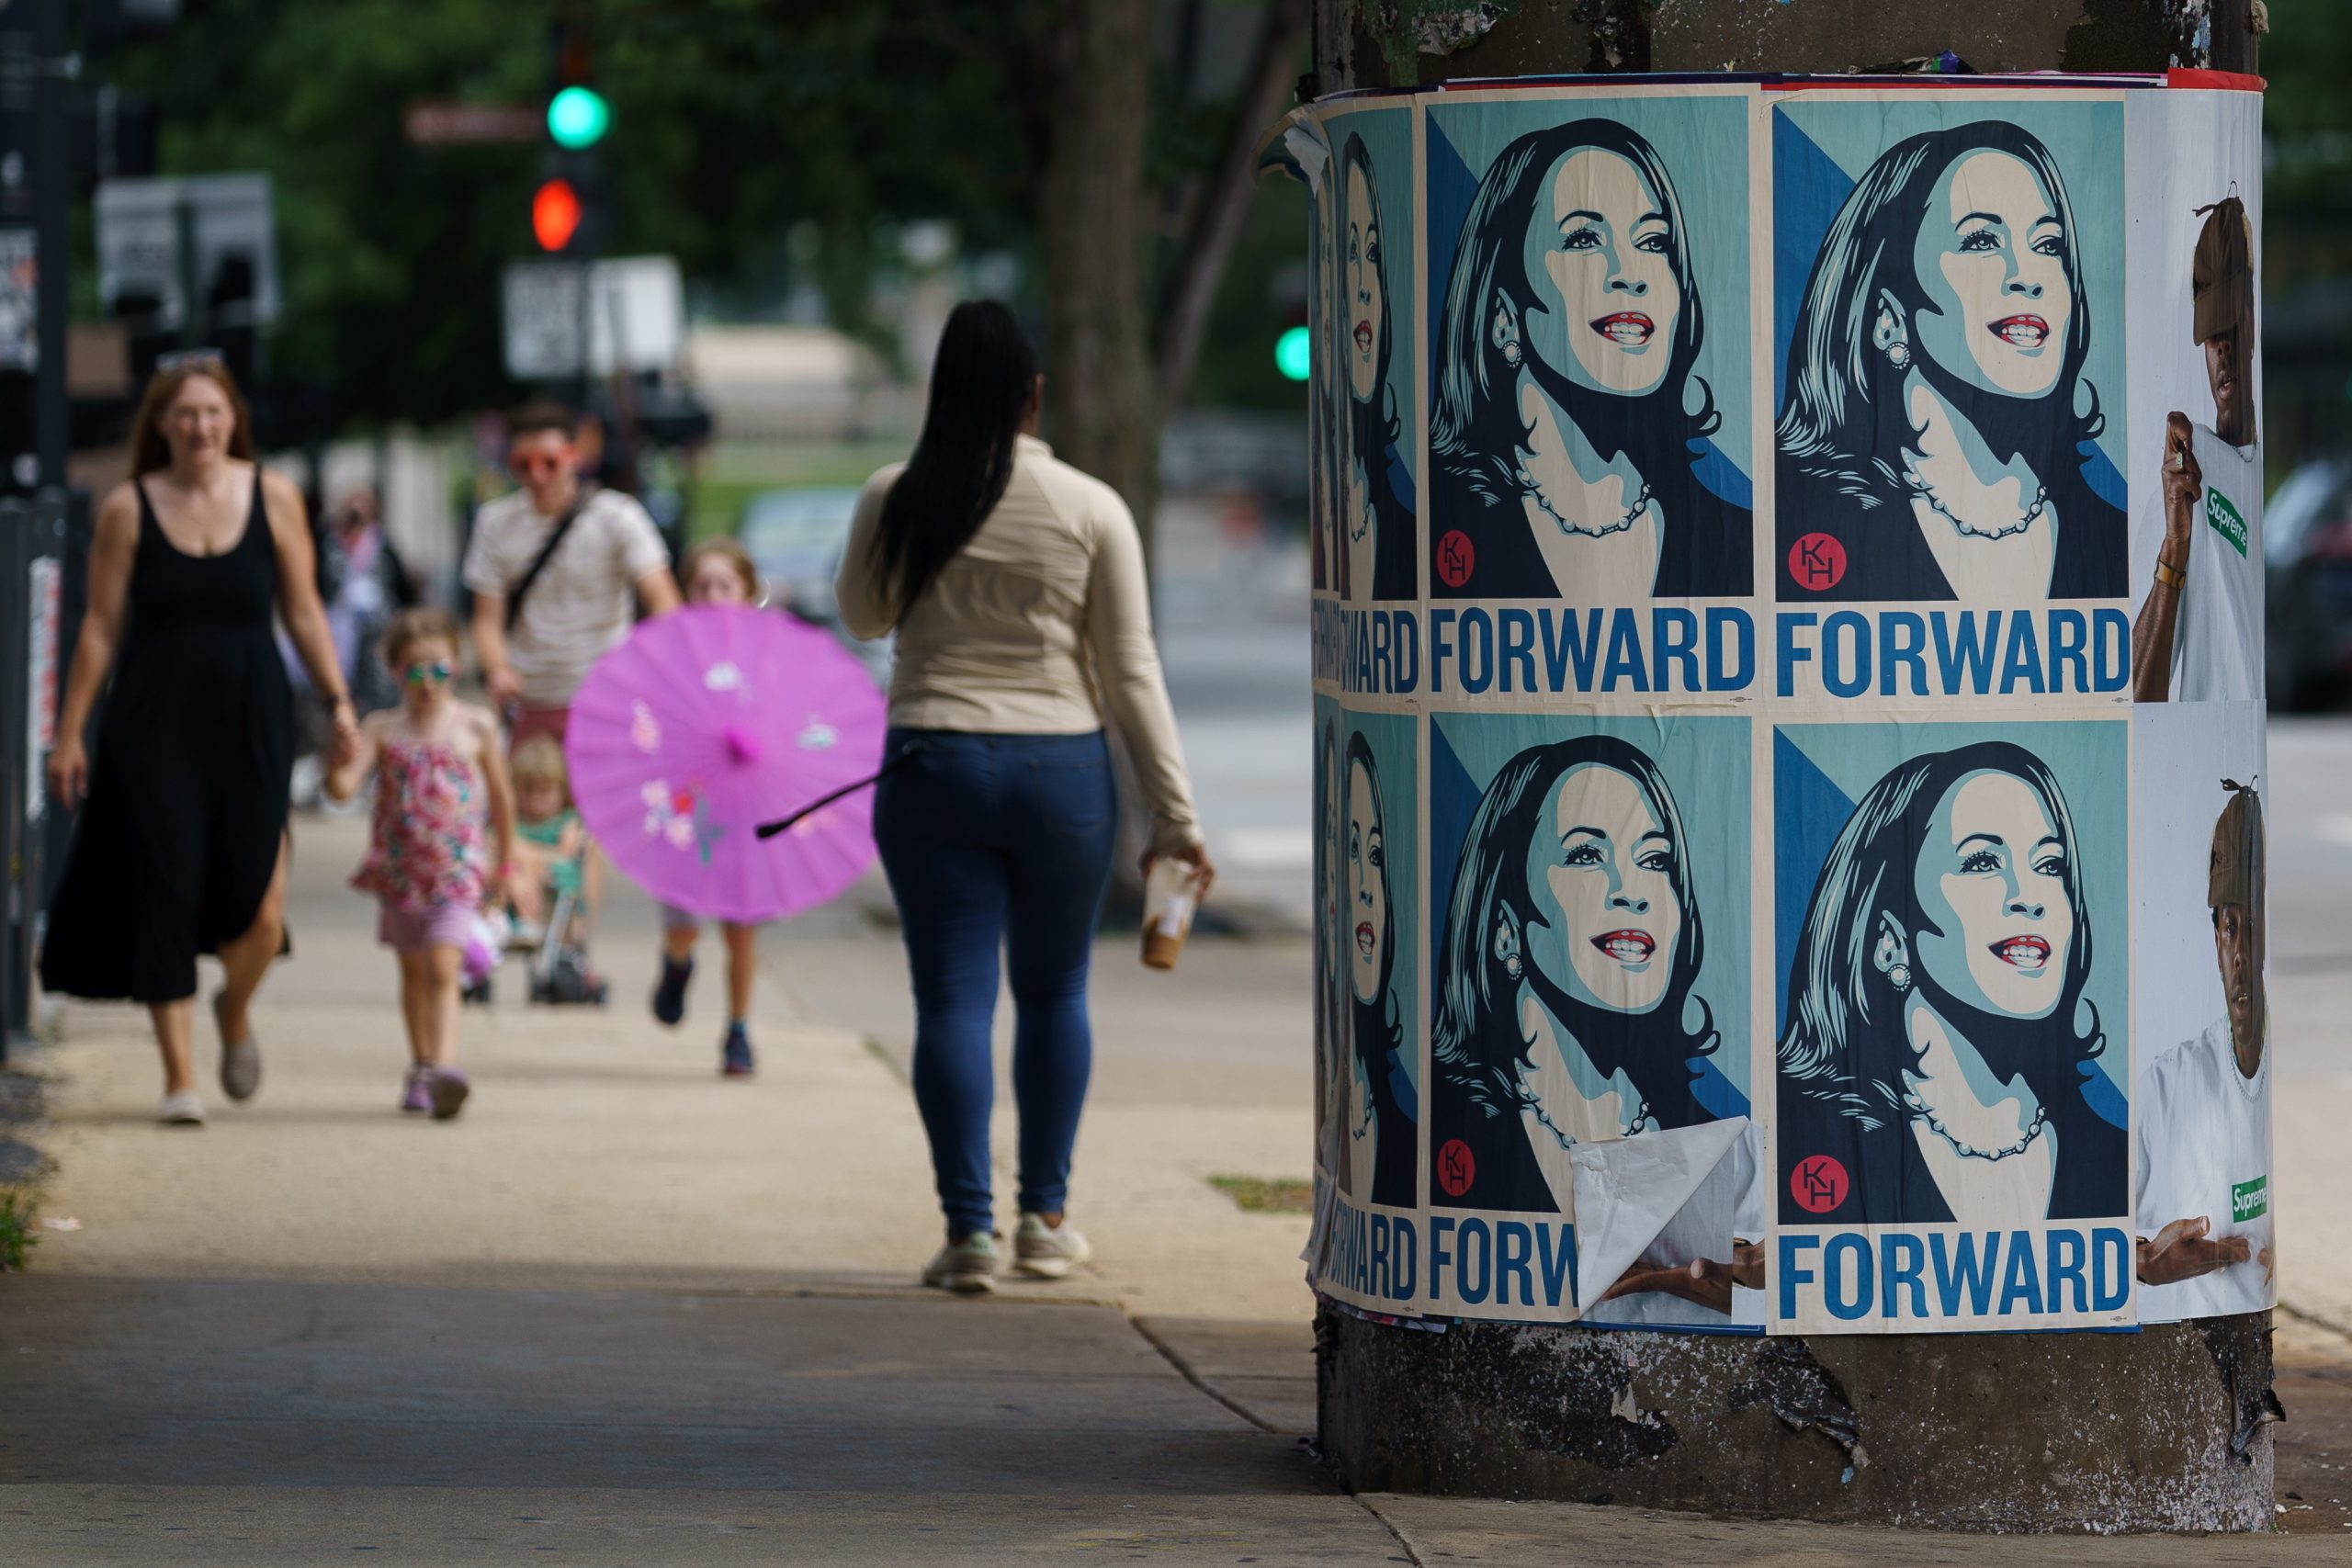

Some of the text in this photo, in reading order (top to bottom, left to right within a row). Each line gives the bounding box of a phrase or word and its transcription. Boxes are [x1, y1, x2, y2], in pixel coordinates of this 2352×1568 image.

[2208, 492, 2247, 547] Supreme
[1444, 536, 1466, 581] KH
[1802, 539, 1833, 583] KH
[1430, 606, 1756, 694] FORWARD
[1776, 607, 2131, 698] FORWARD
[1444, 1145, 1466, 1190] KH
[1804, 1161, 1836, 1206] KH
[1429, 1216, 1579, 1308] FORW
[1779, 1226, 2131, 1321] FORWARD
